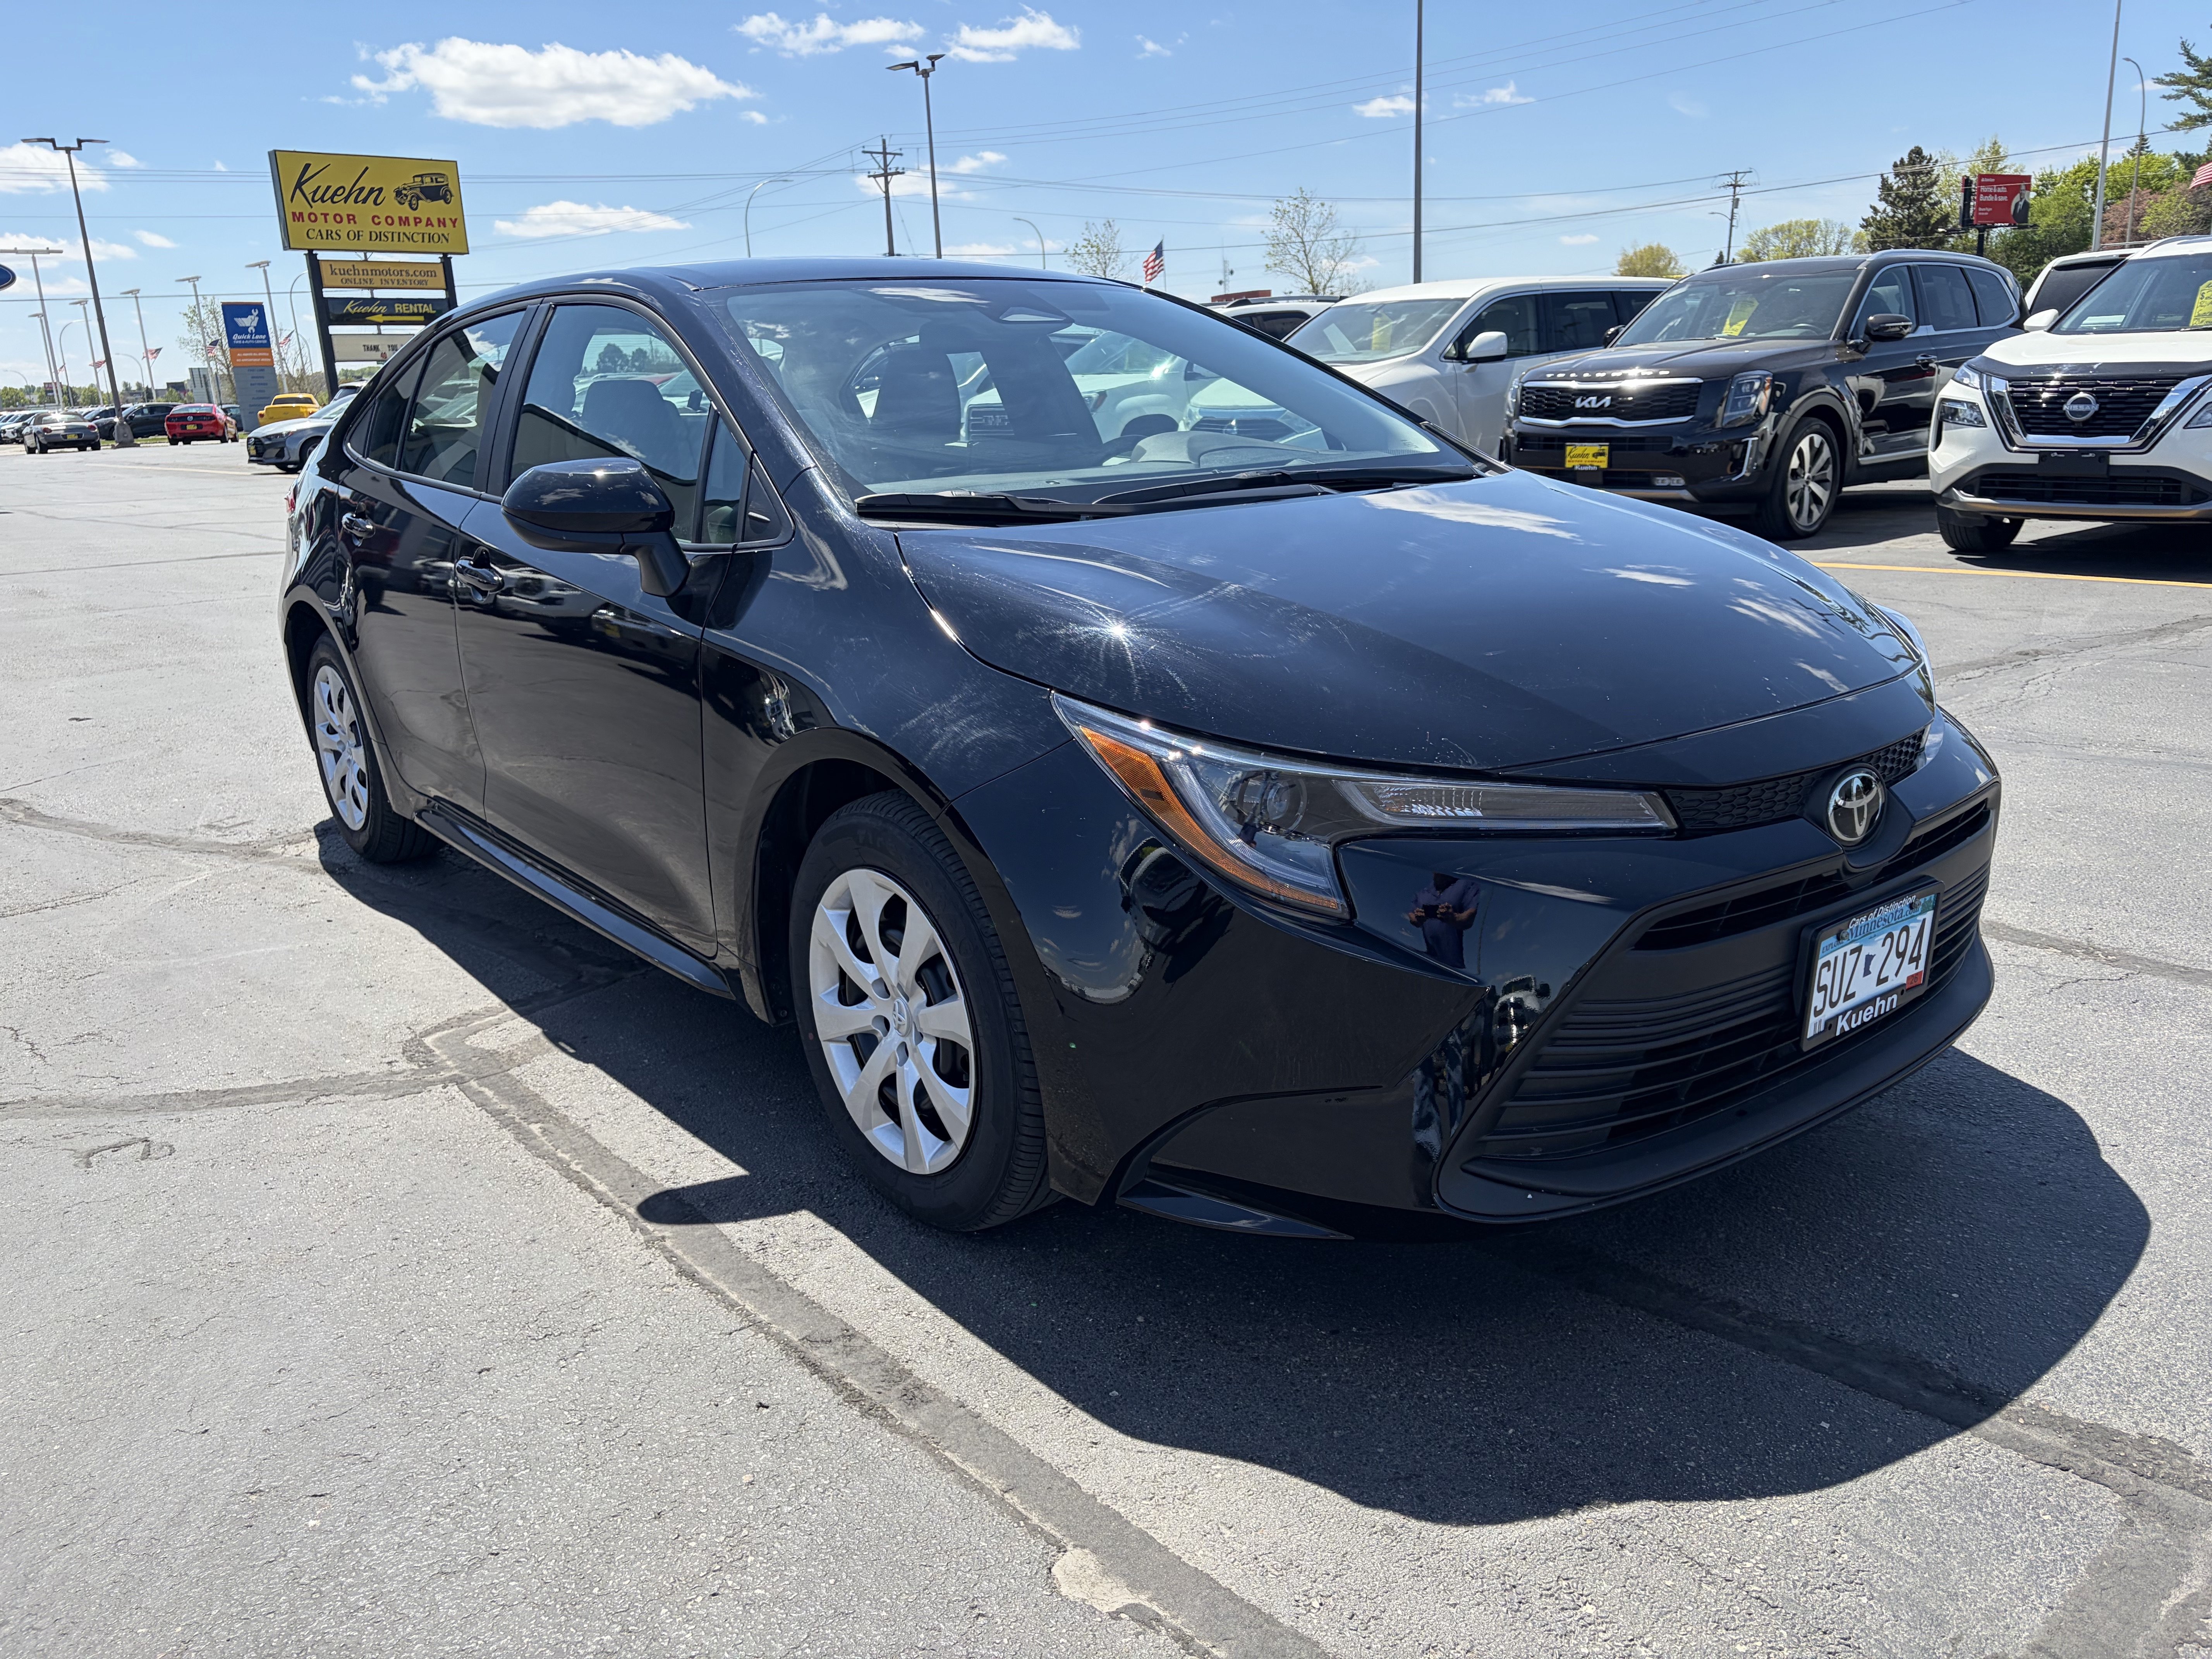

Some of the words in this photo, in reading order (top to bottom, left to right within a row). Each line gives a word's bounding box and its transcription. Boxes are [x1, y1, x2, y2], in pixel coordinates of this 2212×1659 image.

[290, 163, 386, 209] Kuehn
[292, 211, 357, 225] MOTOR
[371, 215, 458, 228] COMPANY
[306, 228, 341, 240] CARS
[347, 230, 364, 241] OF
[369, 230, 450, 244] DISTINCTION
[330, 264, 437, 278] kuehnmotors.com
[343, 300, 387, 314] Kuehn
[395, 303, 436, 314] RENTAL
[1575, 396, 1611, 408] KIA
[1568, 446, 1590, 460] Kuehn
[1849, 918, 1867, 929] Cars
[1868, 910, 1877, 921] of
[1877, 895, 1916, 918] Distinction
[1814, 945, 1863, 1018] SUZ
[1876, 918, 1926, 987] 294
[1910, 975, 1918, 985] 26
[1836, 994, 1898, 1036] Kuehn
